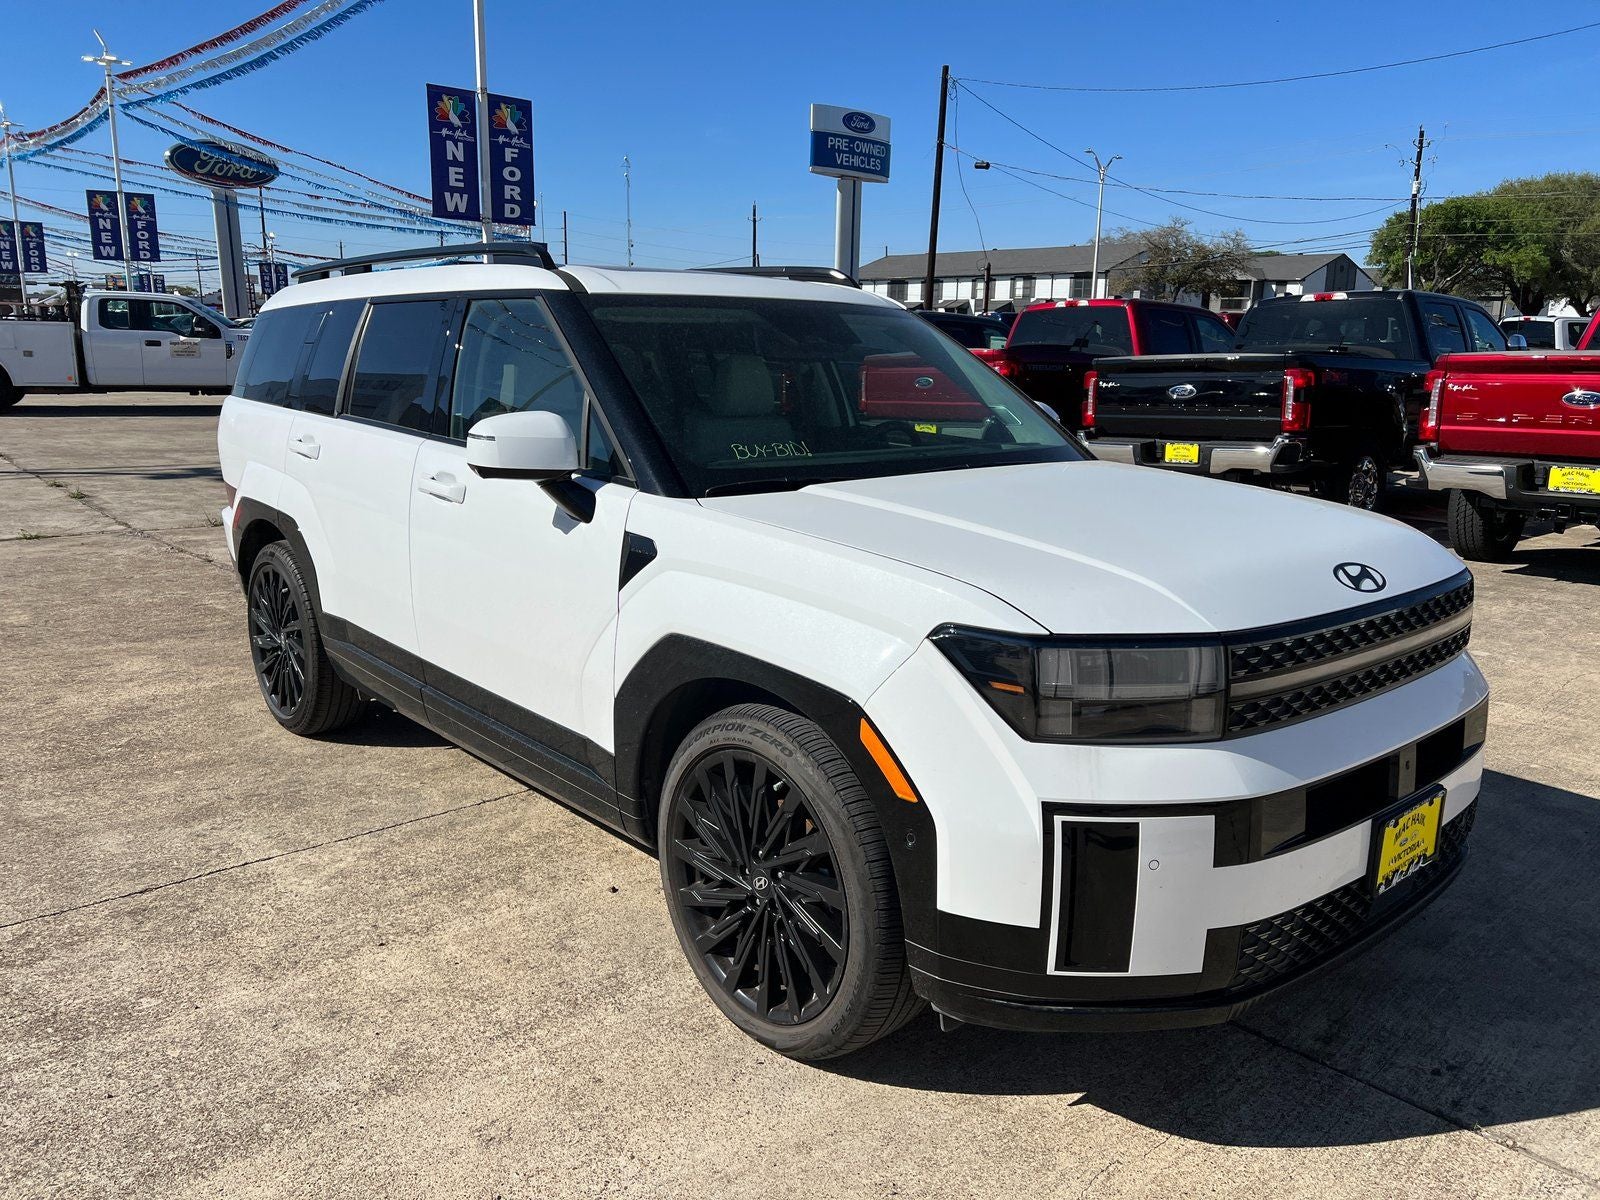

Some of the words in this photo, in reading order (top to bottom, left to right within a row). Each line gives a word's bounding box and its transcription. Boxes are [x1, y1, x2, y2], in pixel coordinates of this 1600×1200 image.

[850, 115, 870, 129] Ford
[828, 137, 886, 157] PRE-OWNED
[835, 152, 881, 171] VEHICLES
[444, 140, 468, 213] NEW
[502, 148, 522, 219] FORD
[98, 218, 116, 257] NEW
[136, 220, 151, 259] FORD
[0, 241, 13, 270] NEW
[29, 242, 40, 271] FORD
[748, 728, 795, 758] ZERO
[1394, 816, 1410, 843] MAC
[1411, 813, 1426, 826] HAIK
